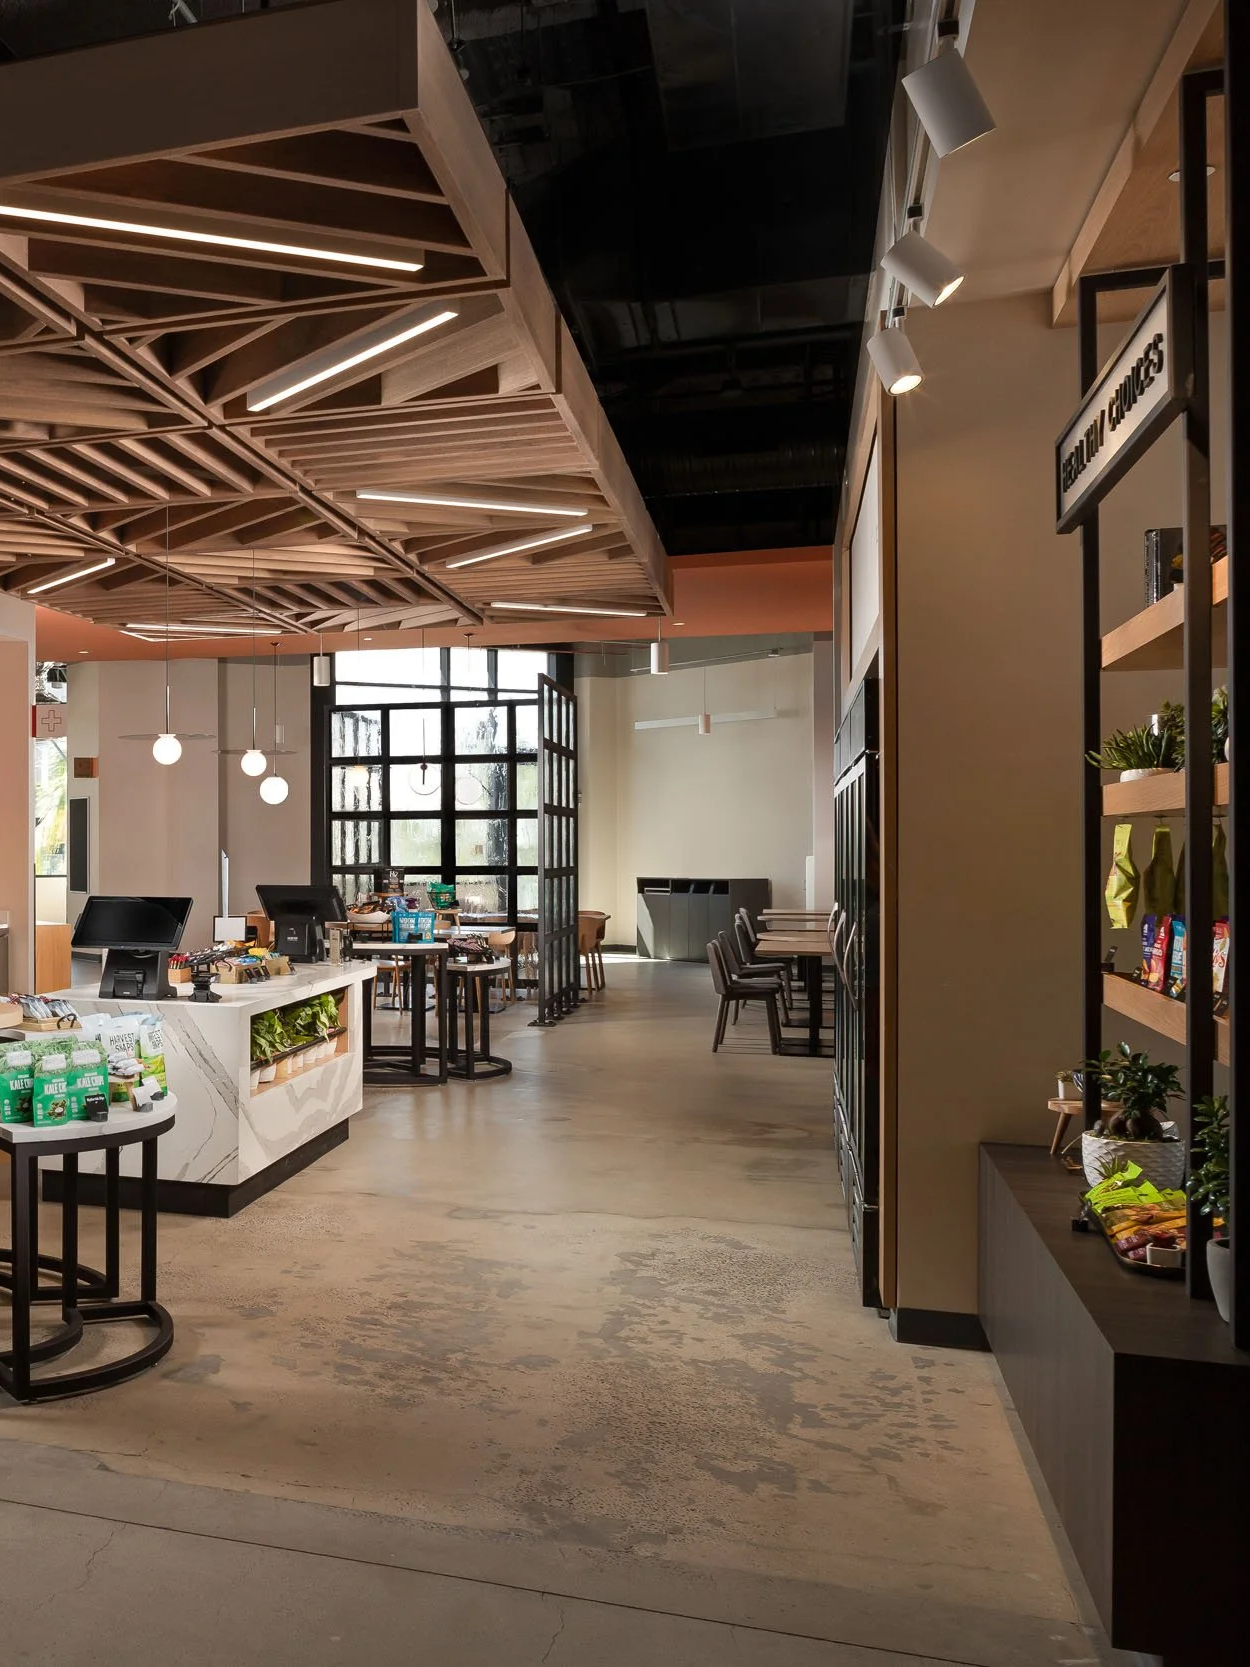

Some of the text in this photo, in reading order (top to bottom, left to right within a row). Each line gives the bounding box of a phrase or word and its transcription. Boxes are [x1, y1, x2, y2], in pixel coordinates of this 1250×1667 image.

[1061, 333, 1164, 493] HEALTHY CHOICES
[110, 1033, 135, 1046] HARVEST
[10, 1079, 25, 1091] KALE
[44, 1083, 58, 1095] KALE
